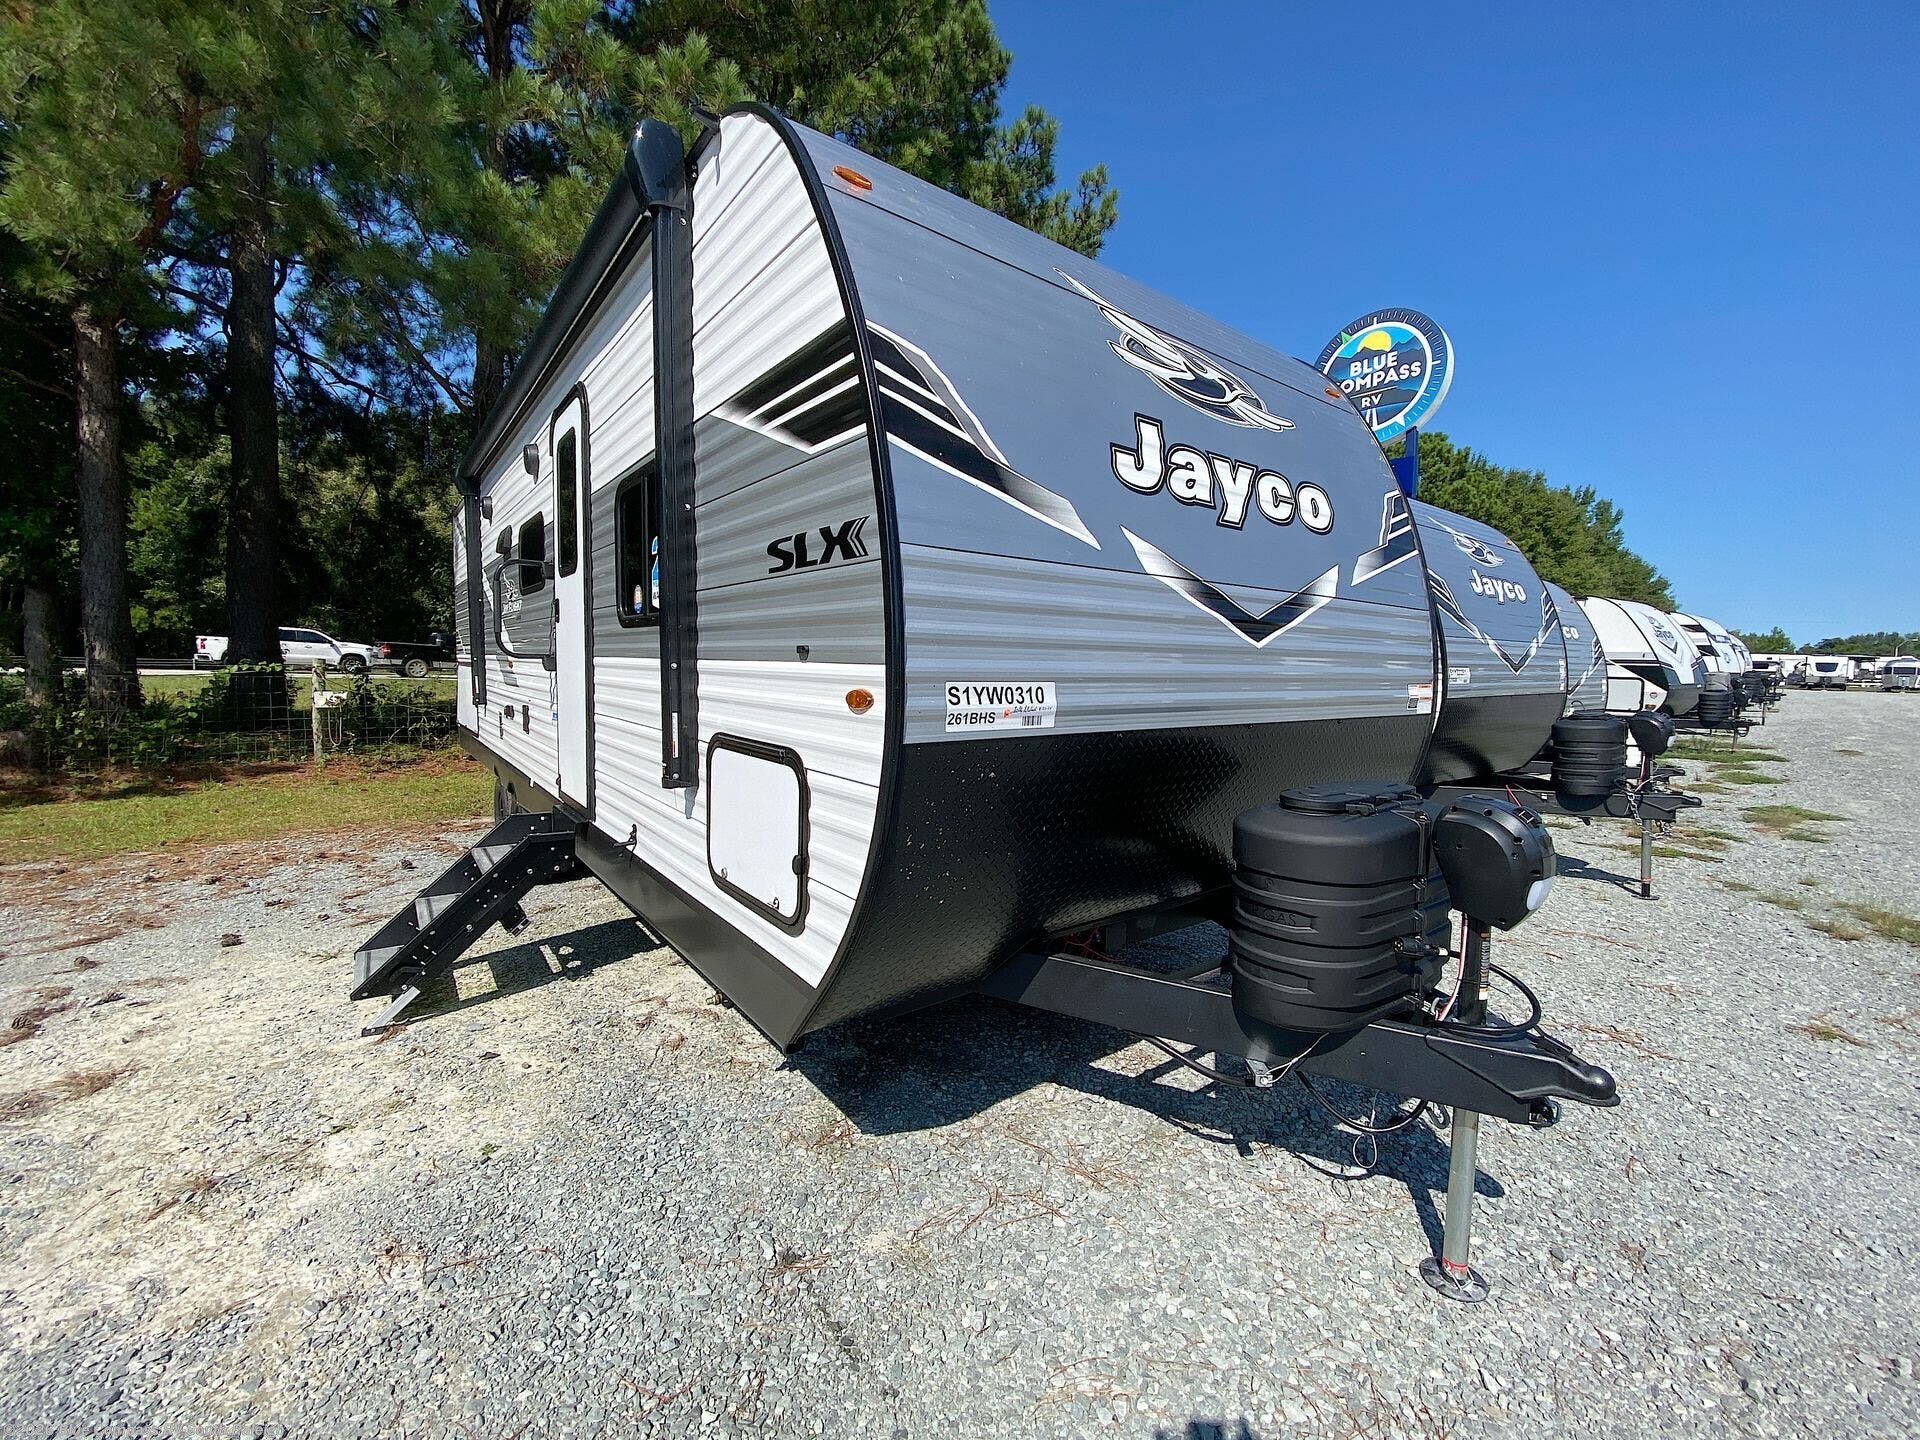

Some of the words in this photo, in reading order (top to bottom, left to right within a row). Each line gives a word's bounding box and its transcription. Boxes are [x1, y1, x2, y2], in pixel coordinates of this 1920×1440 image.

[1336, 361, 1422, 394] OMPASS
[1350, 350, 1398, 377] BLUE
[1361, 393, 1382, 408] RV
[1110, 412, 1334, 535] Jayco
[767, 515, 870, 574] SLX
[1470, 567, 1527, 605] Jayco
[947, 686, 1045, 706] S1YW0310
[947, 712, 996, 726] 261BHS
